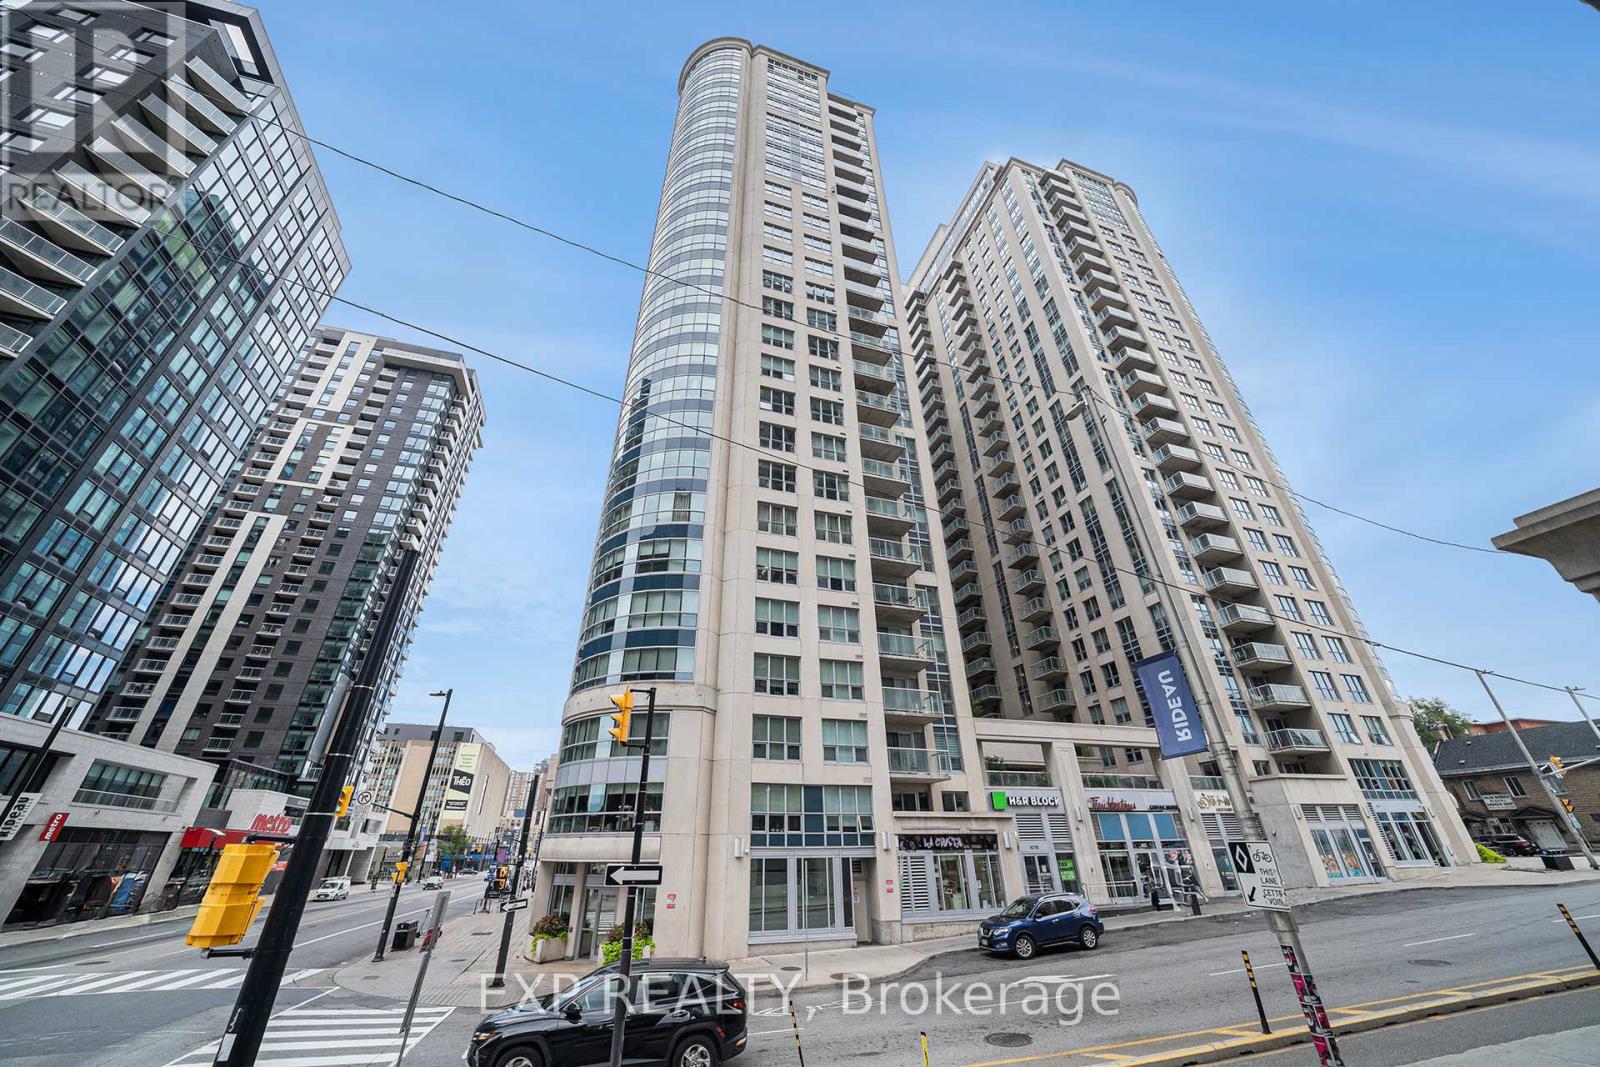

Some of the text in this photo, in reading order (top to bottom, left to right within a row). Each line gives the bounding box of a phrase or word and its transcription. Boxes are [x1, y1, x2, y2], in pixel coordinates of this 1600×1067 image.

[1008, 796, 1061, 806] H&R BLOCK
[45, 814, 63, 840] metro
[1260, 877, 1279, 885] LANE
